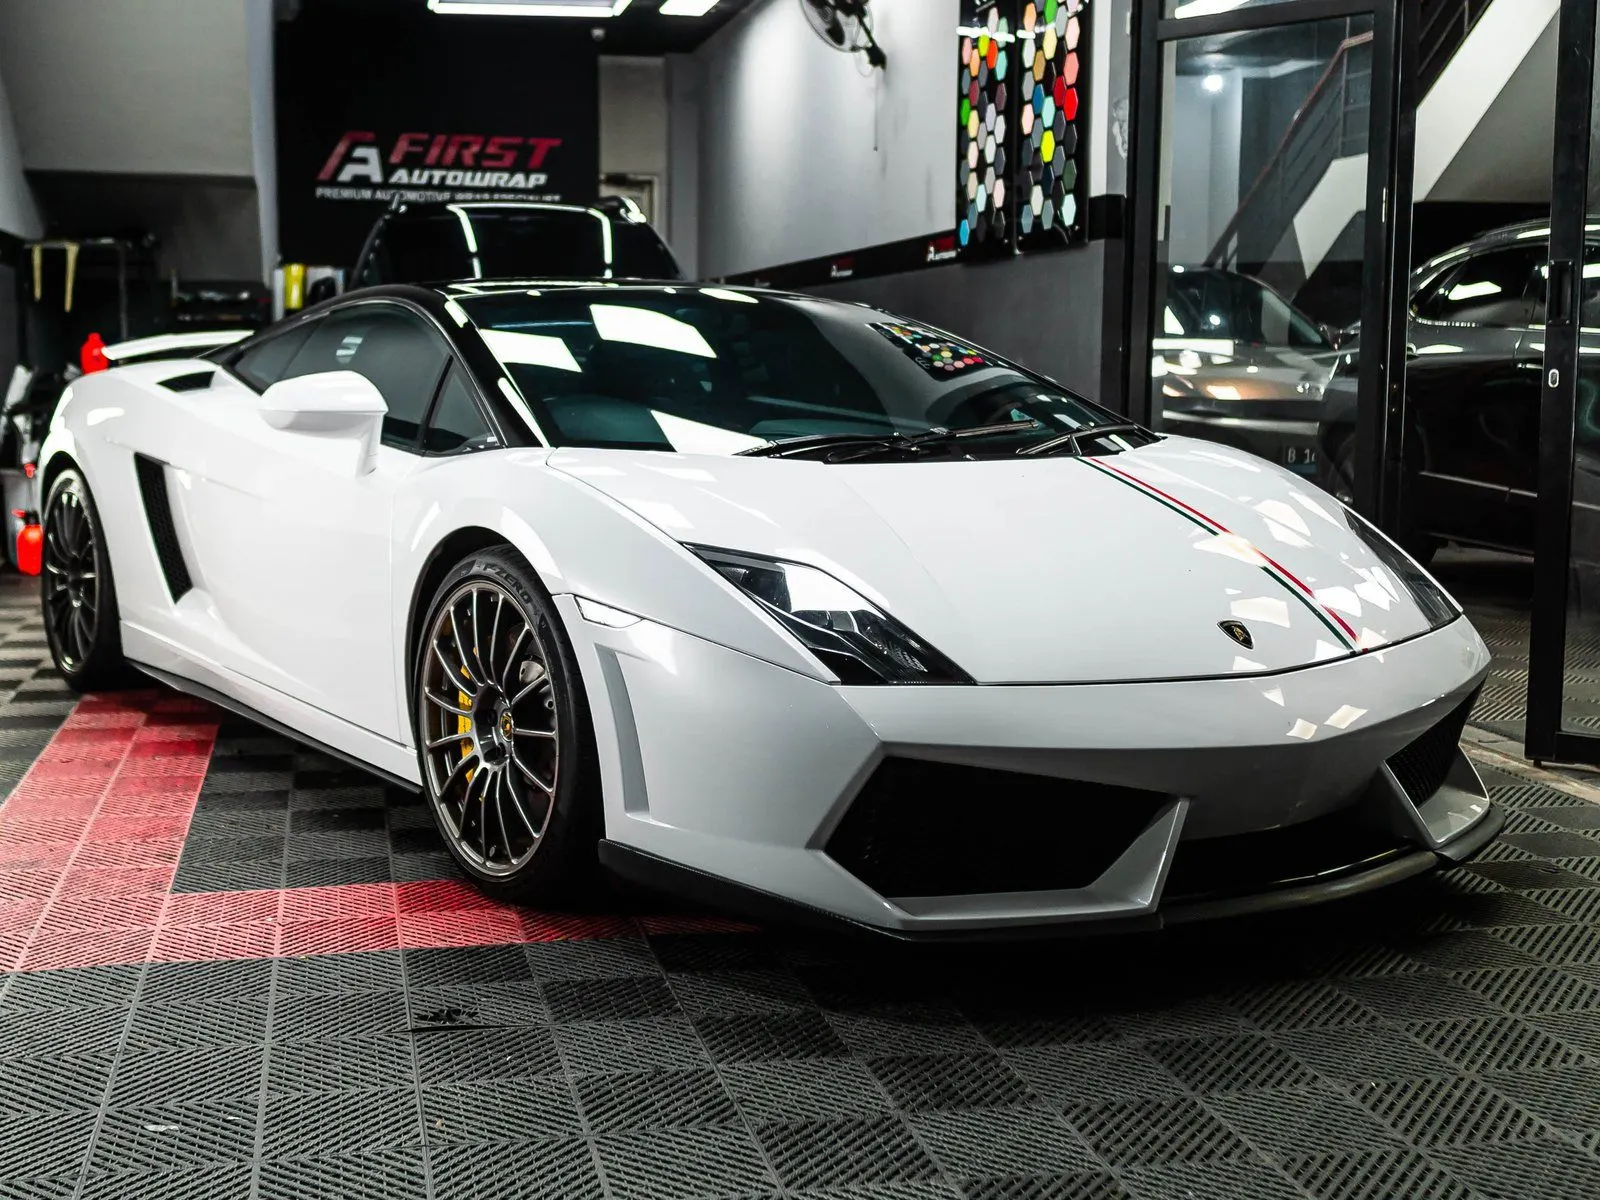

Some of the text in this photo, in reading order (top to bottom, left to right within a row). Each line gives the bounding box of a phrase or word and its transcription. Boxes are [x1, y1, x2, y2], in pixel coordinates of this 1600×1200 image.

[389, 133, 562, 169] FIRST
[388, 168, 548, 189] AUTOWRAP
[315, 187, 372, 200] PREMIUM
